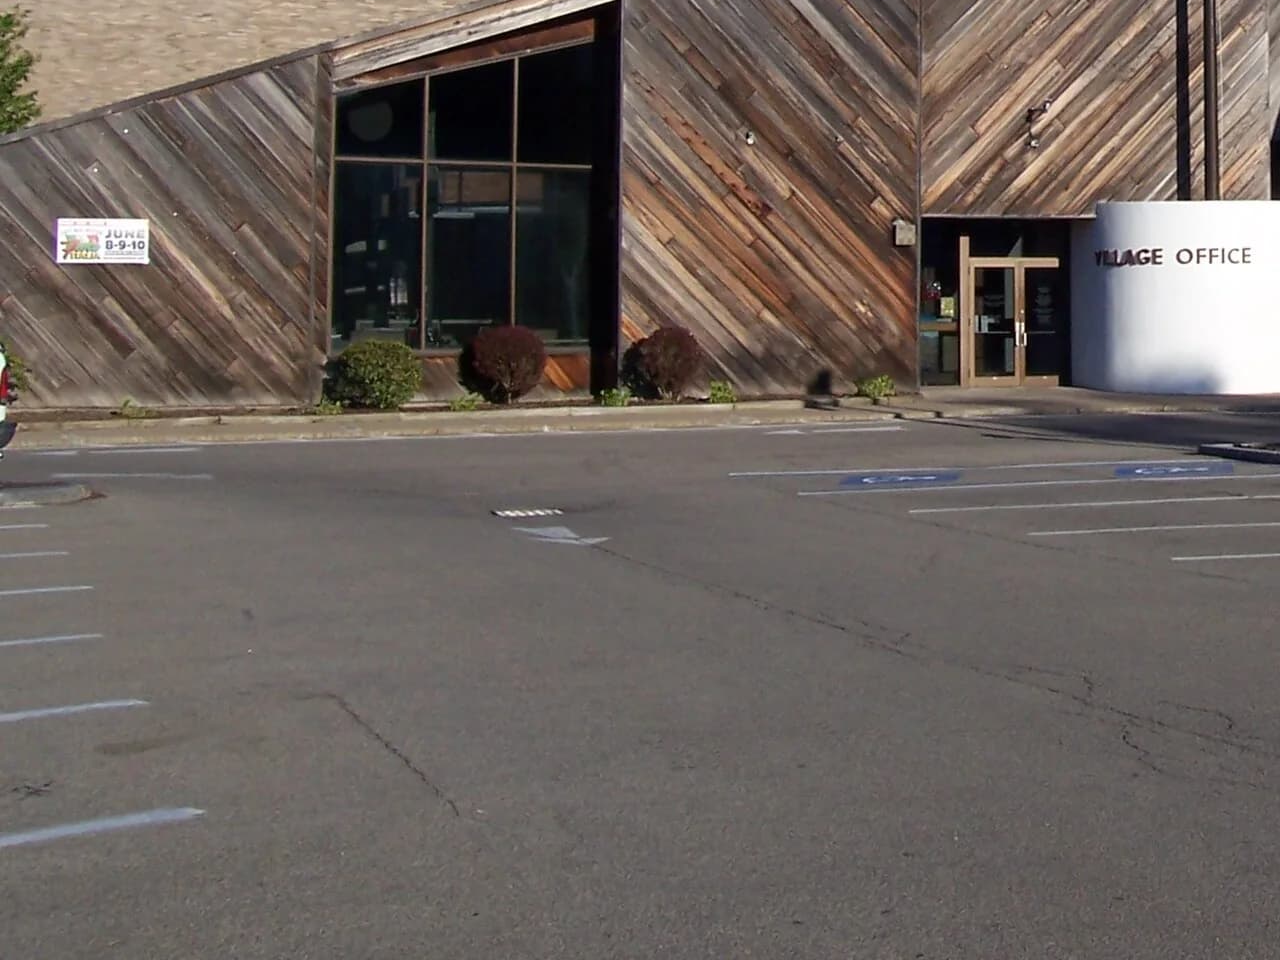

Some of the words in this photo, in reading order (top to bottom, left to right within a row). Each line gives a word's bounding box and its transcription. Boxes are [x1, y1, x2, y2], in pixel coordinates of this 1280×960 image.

[105, 229, 145, 239] JUNE
[105, 240, 146, 250] 8-9-10
[1094, 248, 1163, 267] VILLAGE
[1175, 248, 1252, 265] OFFICE
